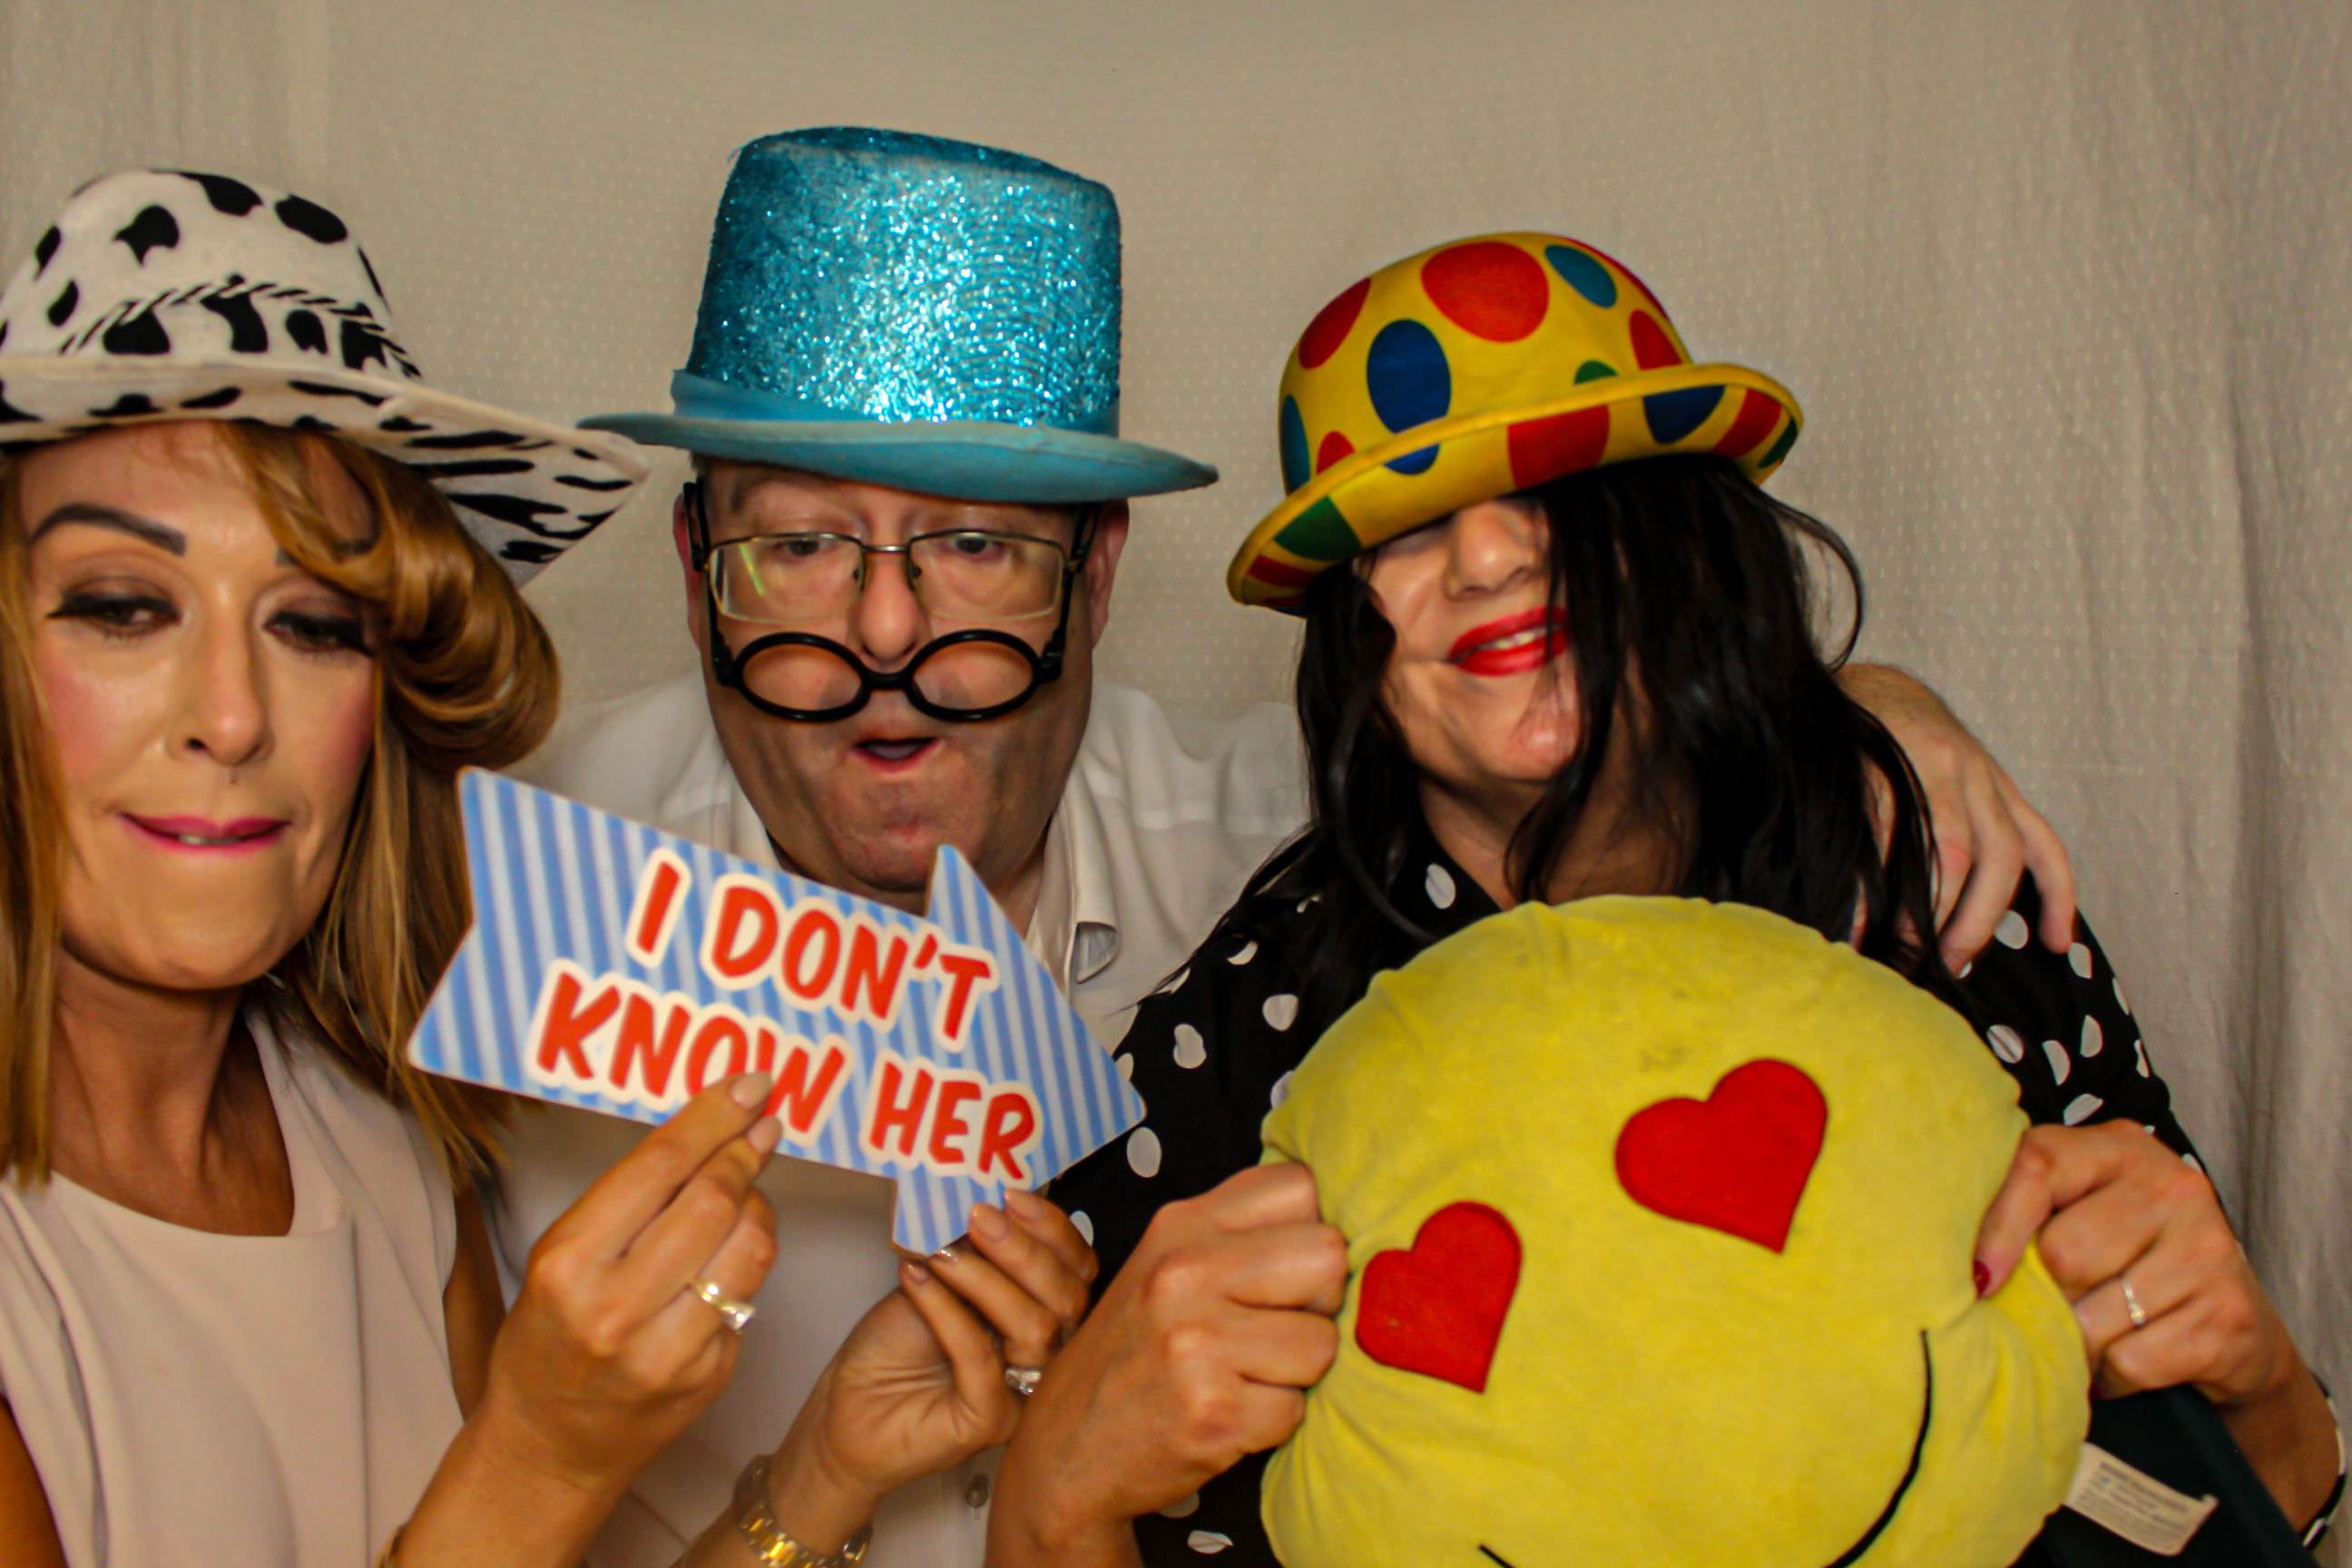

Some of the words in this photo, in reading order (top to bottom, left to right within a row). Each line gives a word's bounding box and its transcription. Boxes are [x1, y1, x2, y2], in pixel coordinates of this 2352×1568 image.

[636, 859, 681, 955] I
[710, 885, 992, 1042] DON'T
[536, 971, 846, 1133] KNOW
[868, 1060, 1036, 1181] HER
